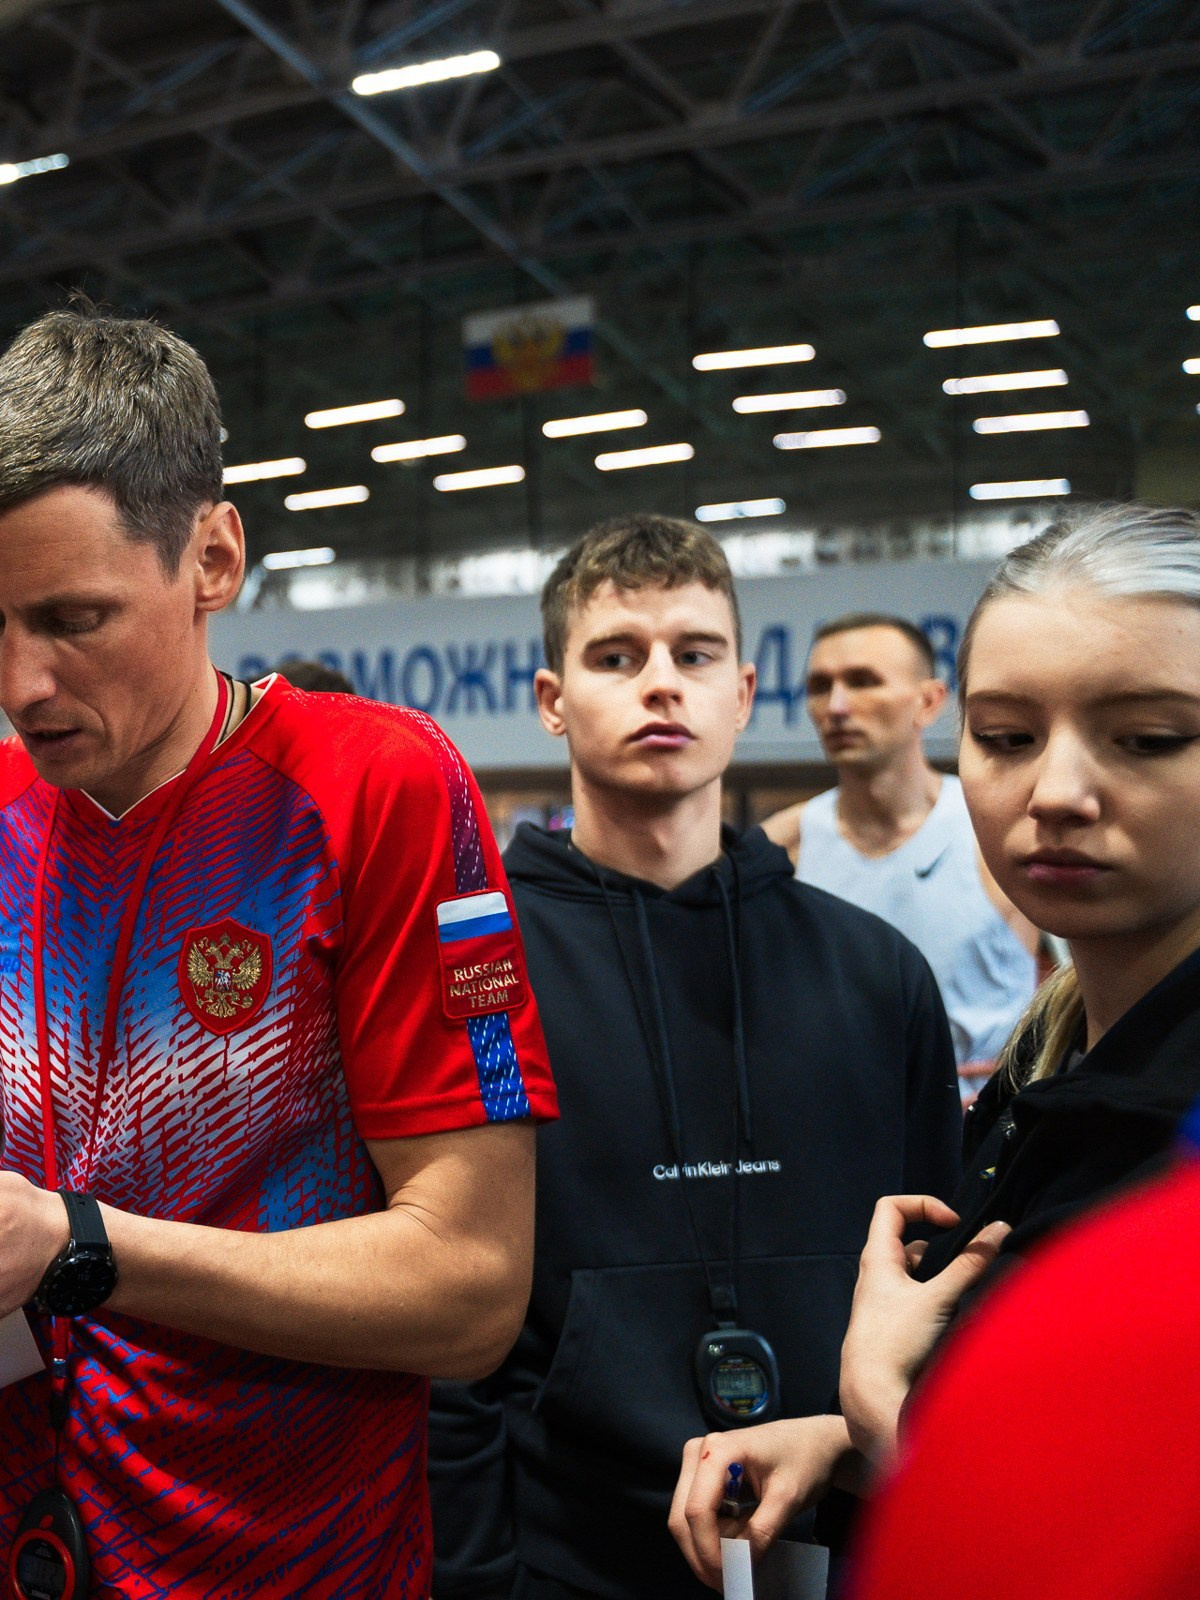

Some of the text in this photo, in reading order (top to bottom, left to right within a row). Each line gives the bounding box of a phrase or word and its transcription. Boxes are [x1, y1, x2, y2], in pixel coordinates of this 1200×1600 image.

[454, 959, 513, 982] RUSSIAN
[450, 974, 519, 997] NATIONAL
[469, 990, 509, 1008] TEAM
